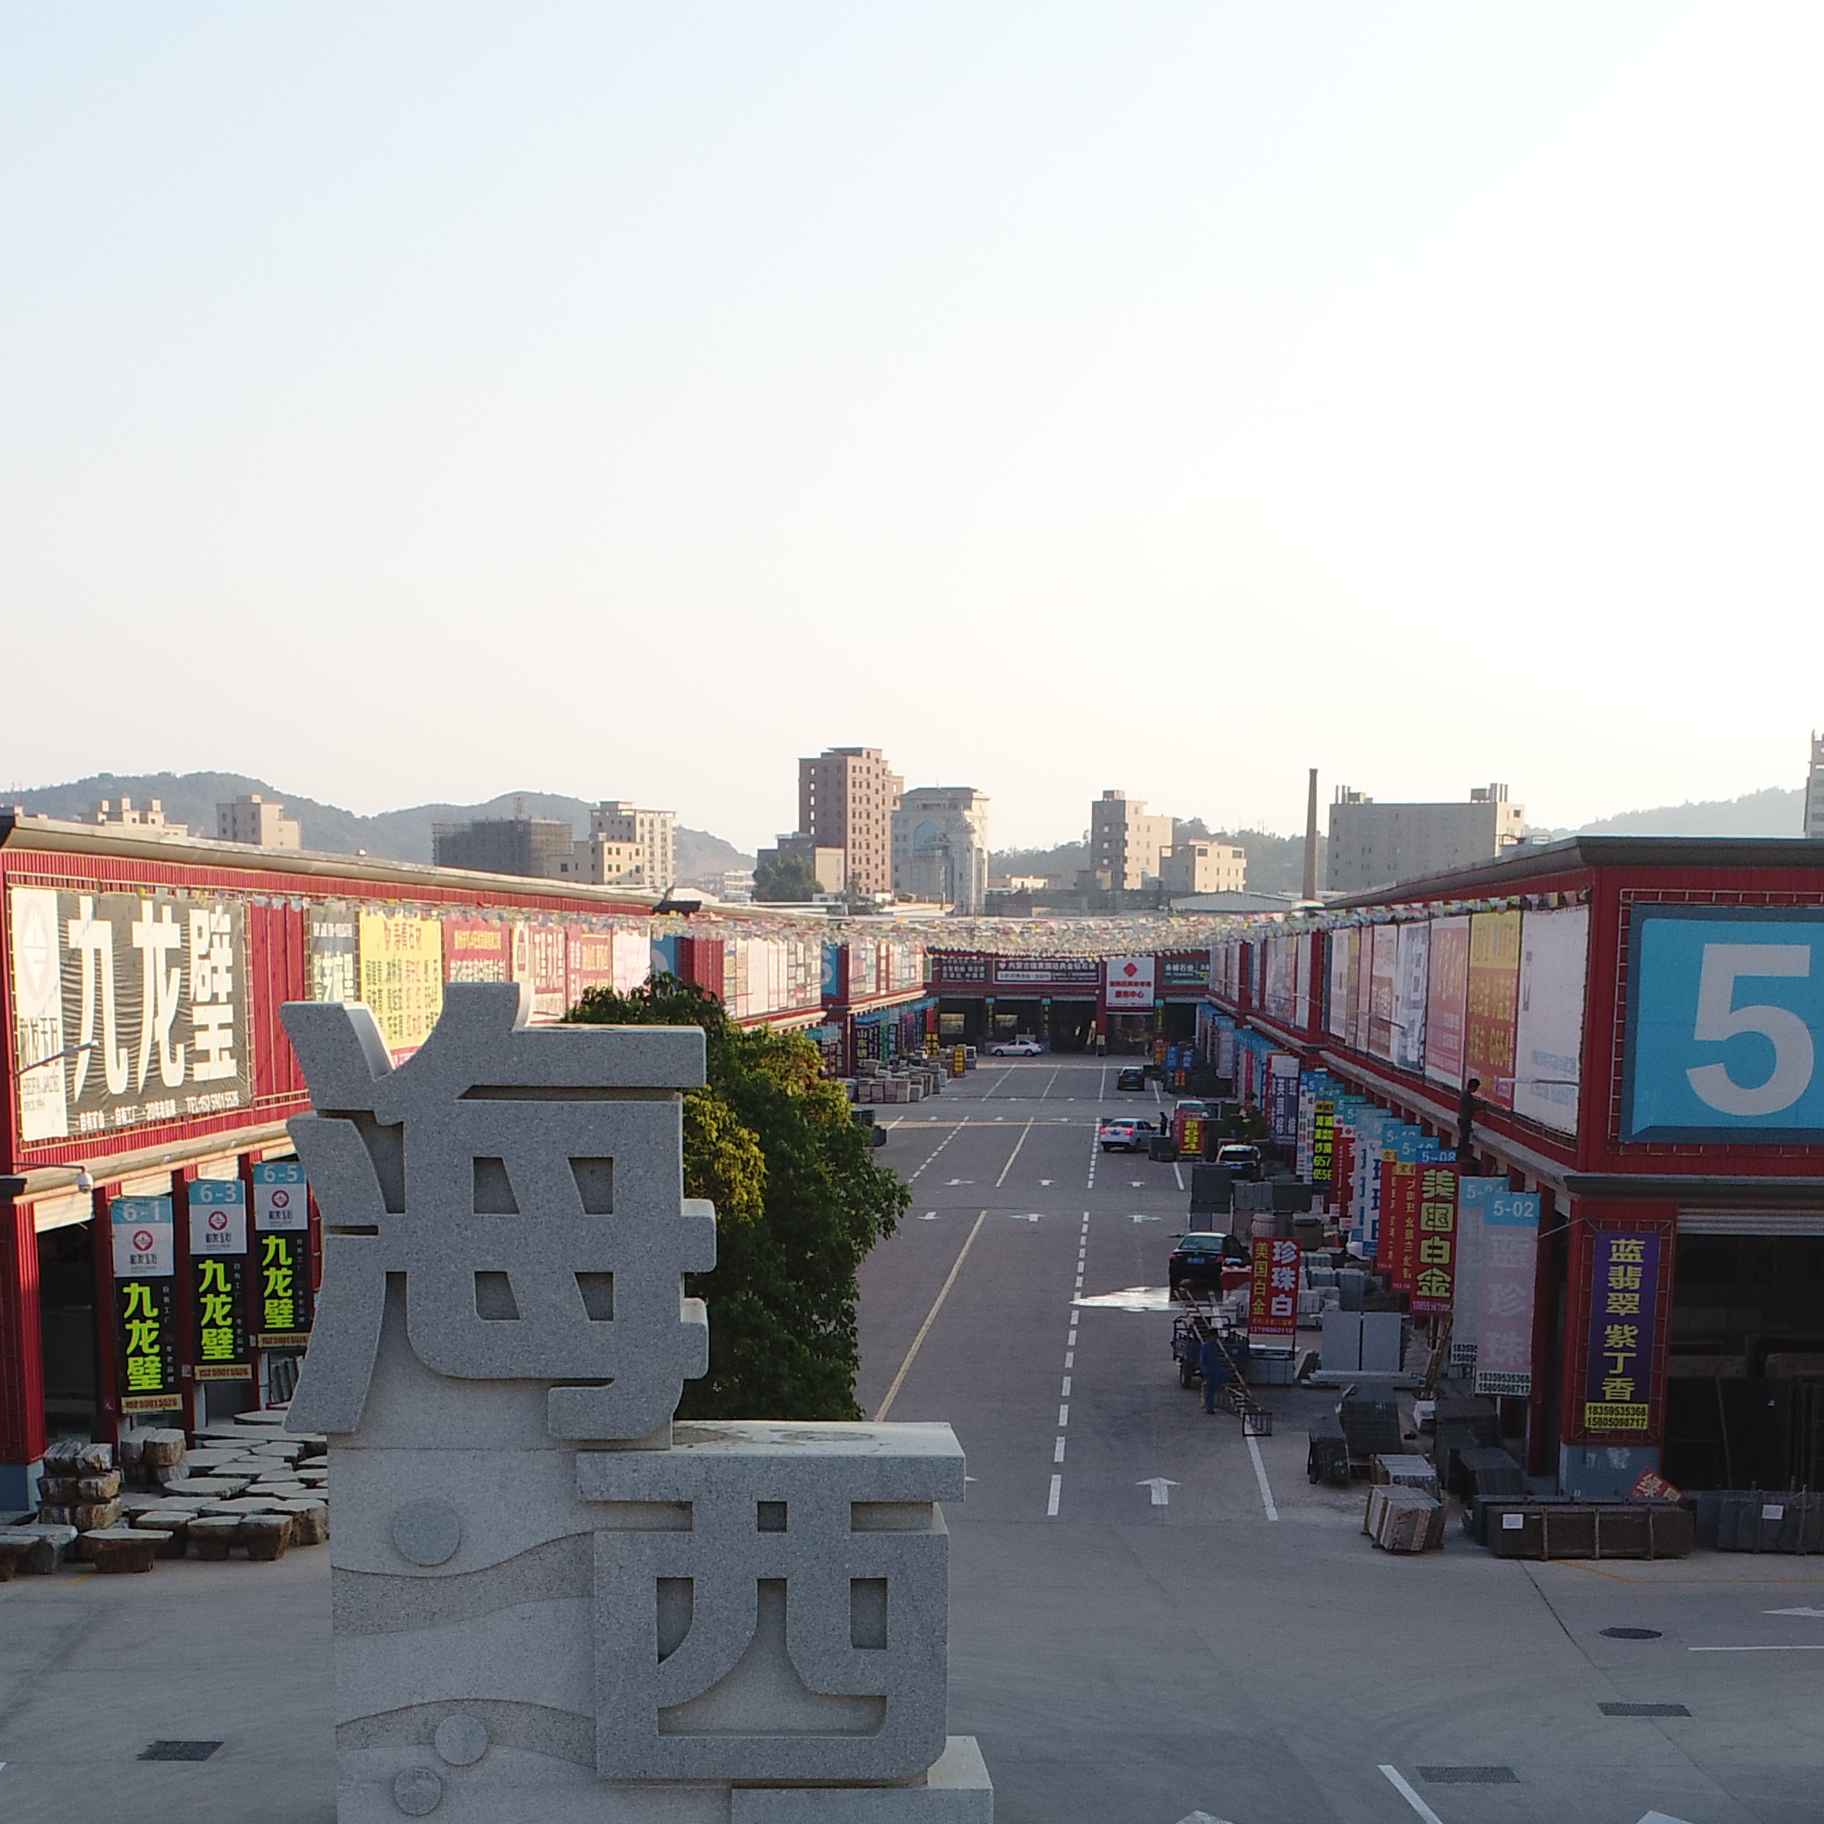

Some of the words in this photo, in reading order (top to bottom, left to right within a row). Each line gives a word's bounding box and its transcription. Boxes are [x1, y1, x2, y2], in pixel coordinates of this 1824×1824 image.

[1685, 943, 1815, 1117] 5
[200, 1184, 237, 1203] 6-3
[263, 1164, 298, 1183] 6-5
[1492, 1200, 1535, 1218] 5-02
[121, 1201, 161, 1222] 6-1
[1416, 1168, 1457, 1298] 美国白金
[1254, 1242, 1268, 1315] 美国白金
[1271, 1241, 1297, 1316] 珍珠白
[1605, 1238, 1646, 1316] 蓝翡翠
[1601, 1323, 1639, 1401] 紫丁香
